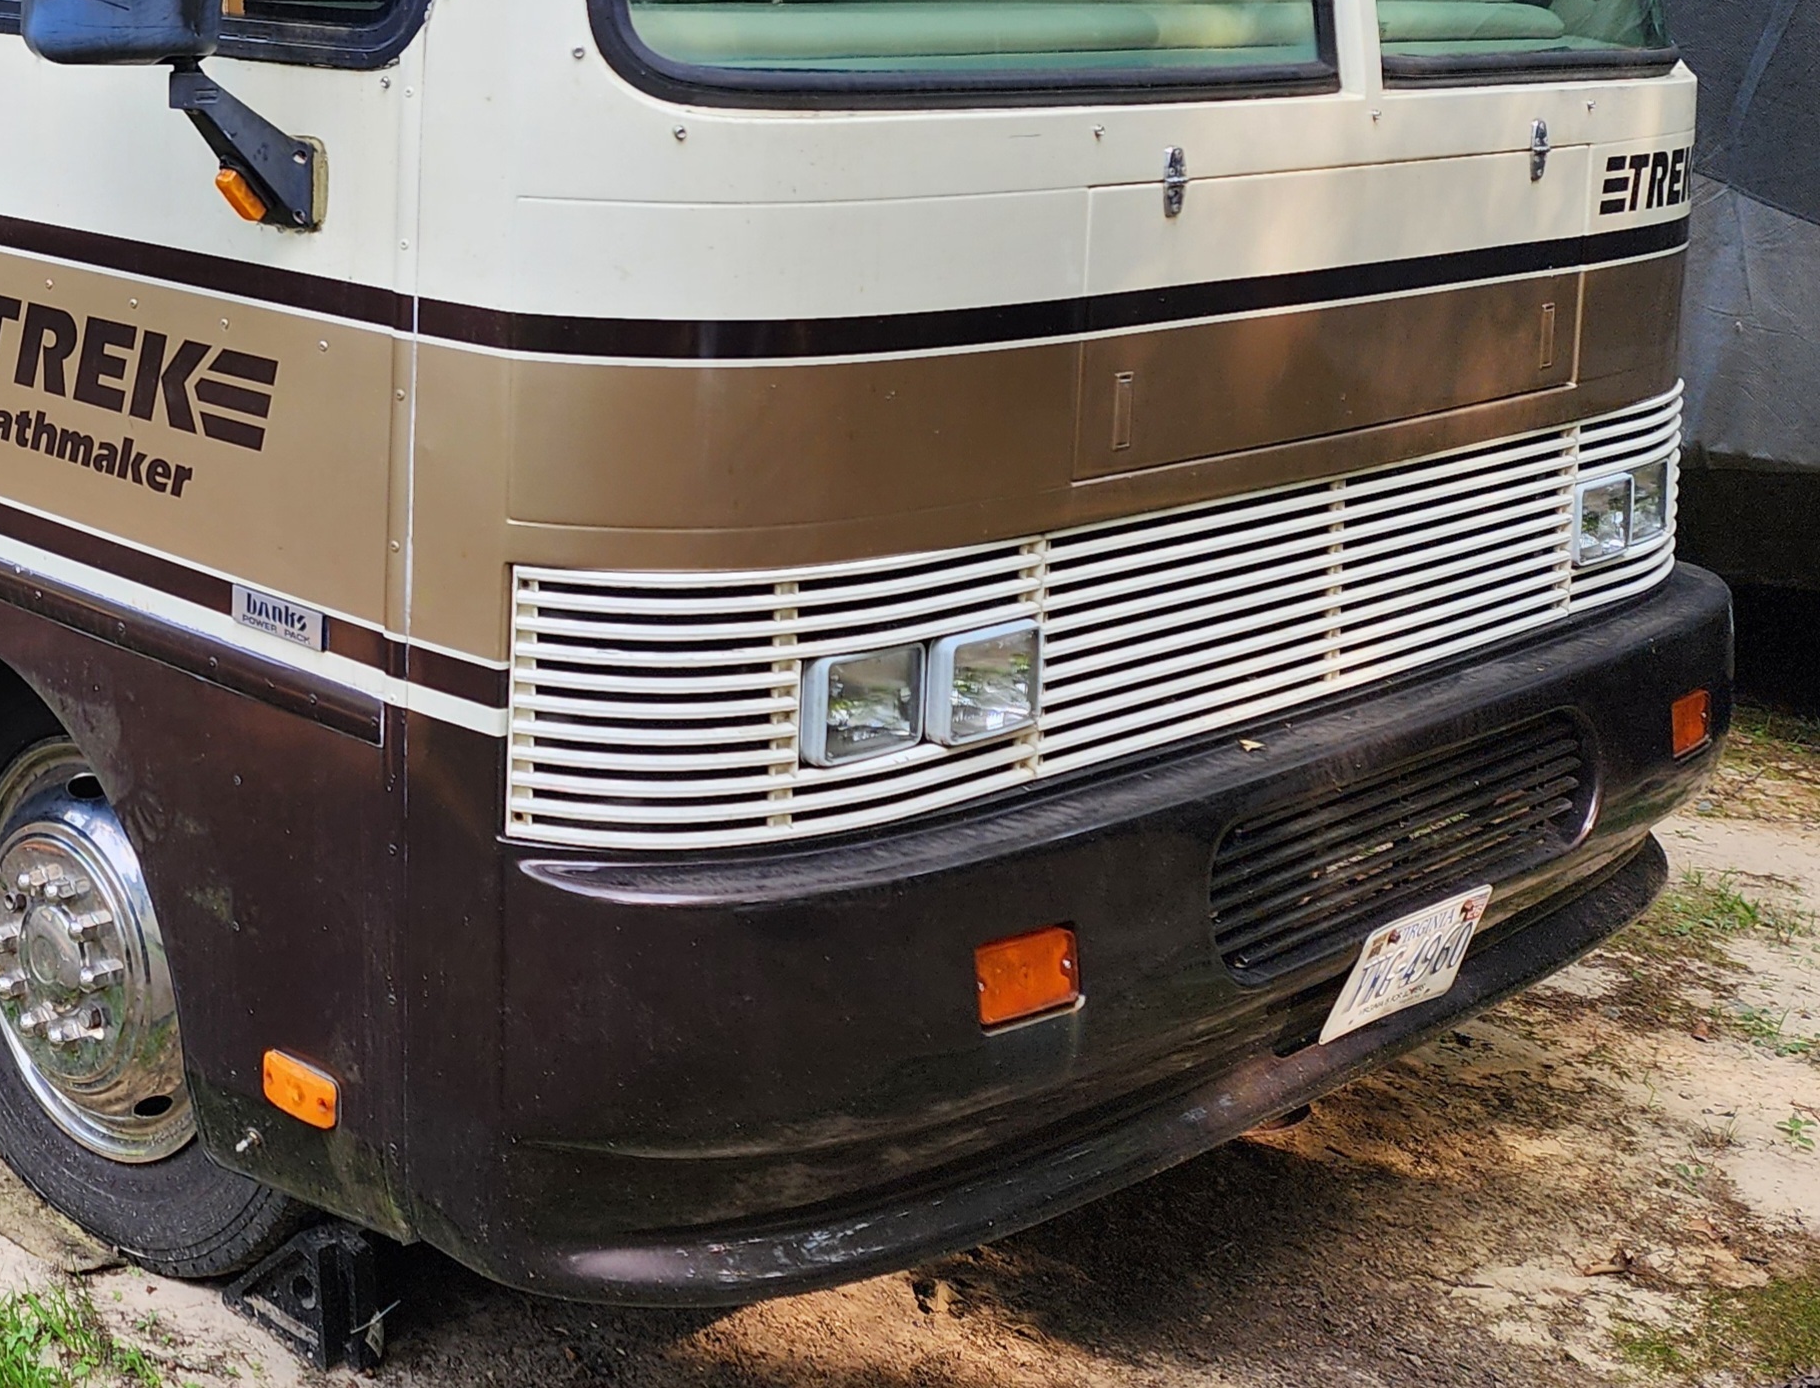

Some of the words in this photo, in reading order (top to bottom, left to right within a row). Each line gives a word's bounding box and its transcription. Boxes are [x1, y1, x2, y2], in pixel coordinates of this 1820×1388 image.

[242, 614, 277, 633] POWER
[284, 629, 311, 645] PACK
[246, 593, 307, 631] banks
[1399, 908, 1456, 943] VIRGINIA
